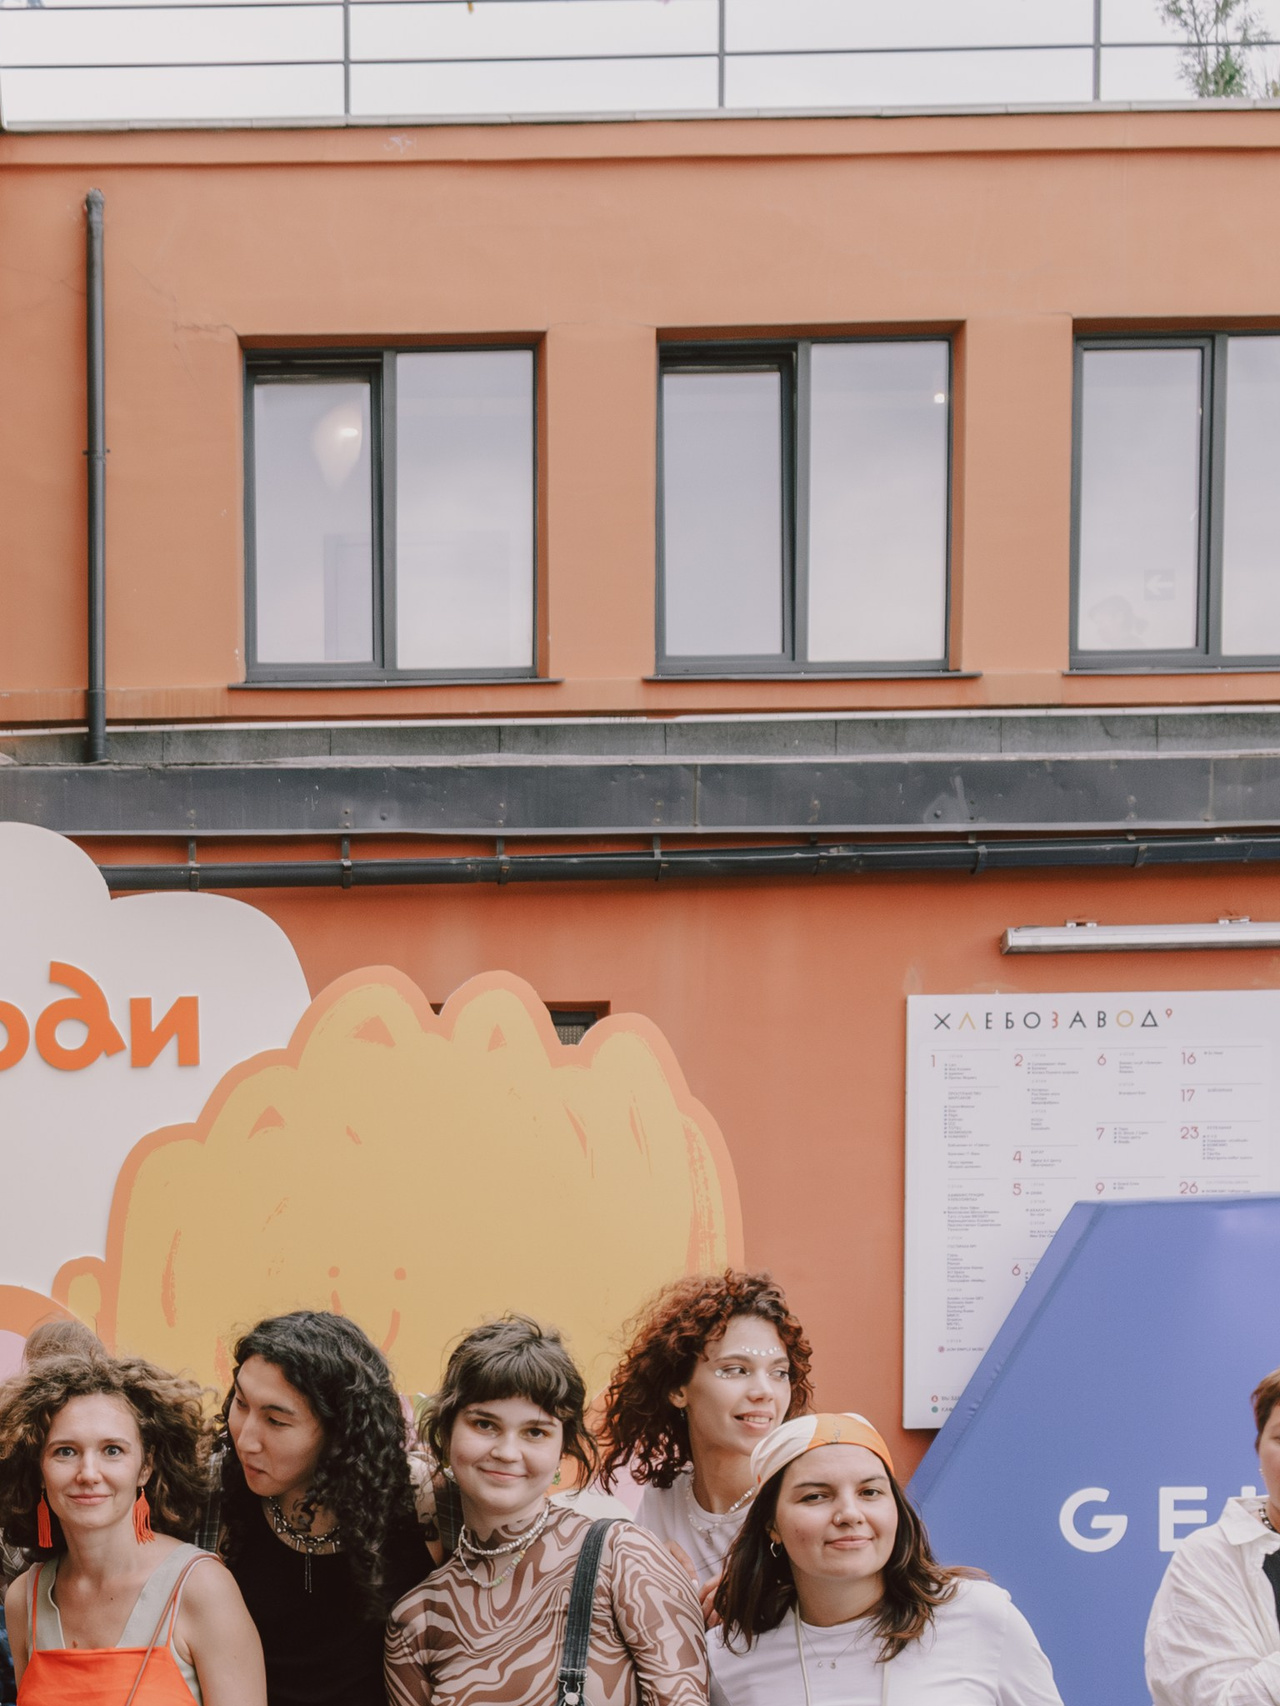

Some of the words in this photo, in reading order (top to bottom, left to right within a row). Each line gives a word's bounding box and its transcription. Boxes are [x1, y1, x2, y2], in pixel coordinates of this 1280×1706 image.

[1014, 1053, 1024, 1067] 2
[1097, 1053, 1107, 1066] 6
[1181, 1051, 1197, 1065] 16
[1180, 1088, 1196, 1102] 17
[1096, 1127, 1105, 1140] 7
[1180, 1126, 1200, 1140] 23
[1012, 1150, 1023, 1163] 4
[1012, 1183, 1022, 1196] 5
[1095, 1182, 1106, 1195] 9
[1179, 1181, 1199, 1195] 26
[1011, 1263, 1021, 1277] 6
[1059, 1486, 1257, 1553] GE
